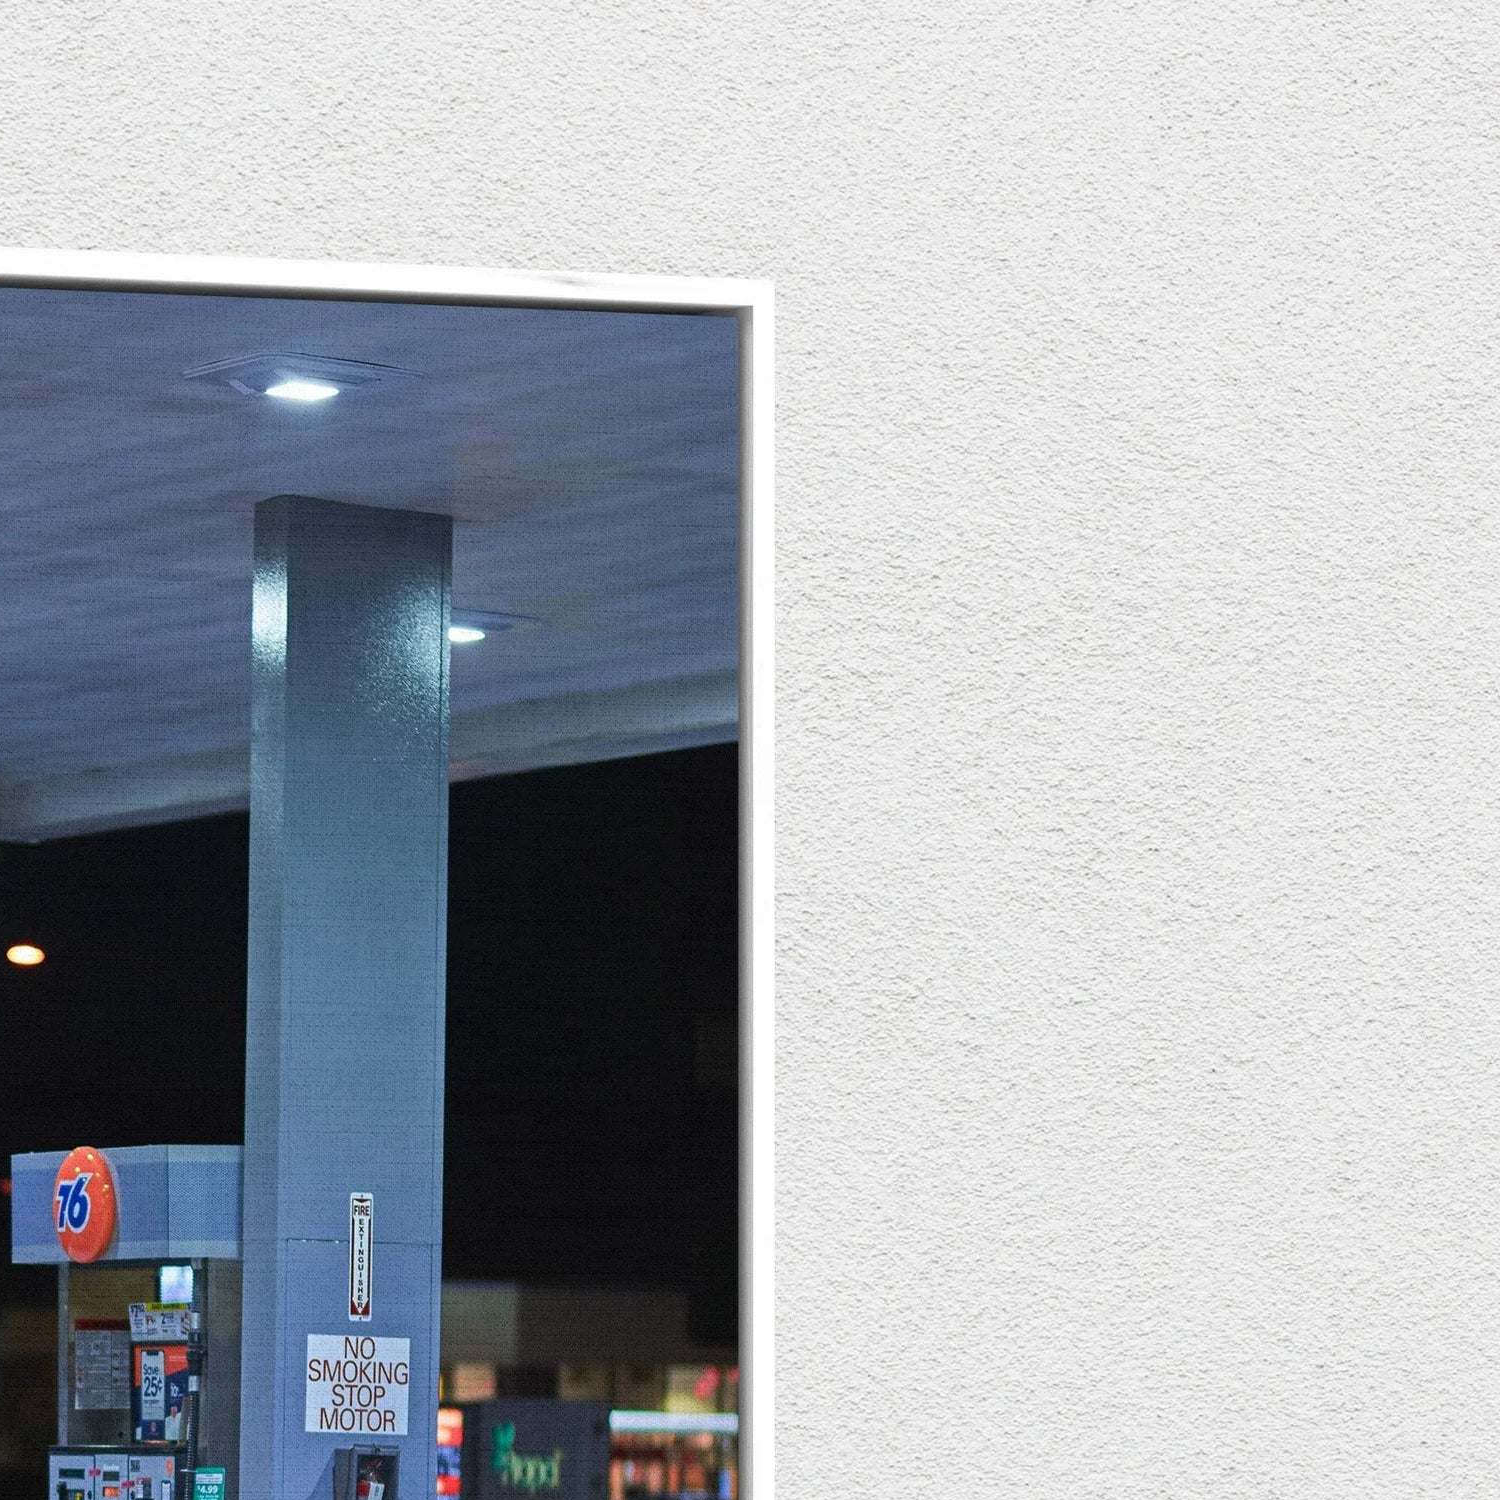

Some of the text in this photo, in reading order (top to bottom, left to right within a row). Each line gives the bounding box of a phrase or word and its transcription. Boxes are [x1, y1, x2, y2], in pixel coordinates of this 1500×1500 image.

[56, 1172, 93, 1233] 76
[353, 1205, 370, 1217] FIRE
[357, 1218, 365, 1309] EXTINGUISHER
[344, 1336, 376, 1360] NO
[143, 1363, 160, 1376] Save
[308, 1358, 408, 1385] SMOKING
[331, 1383, 386, 1408] STOP
[319, 1407, 396, 1432] MOTOR
